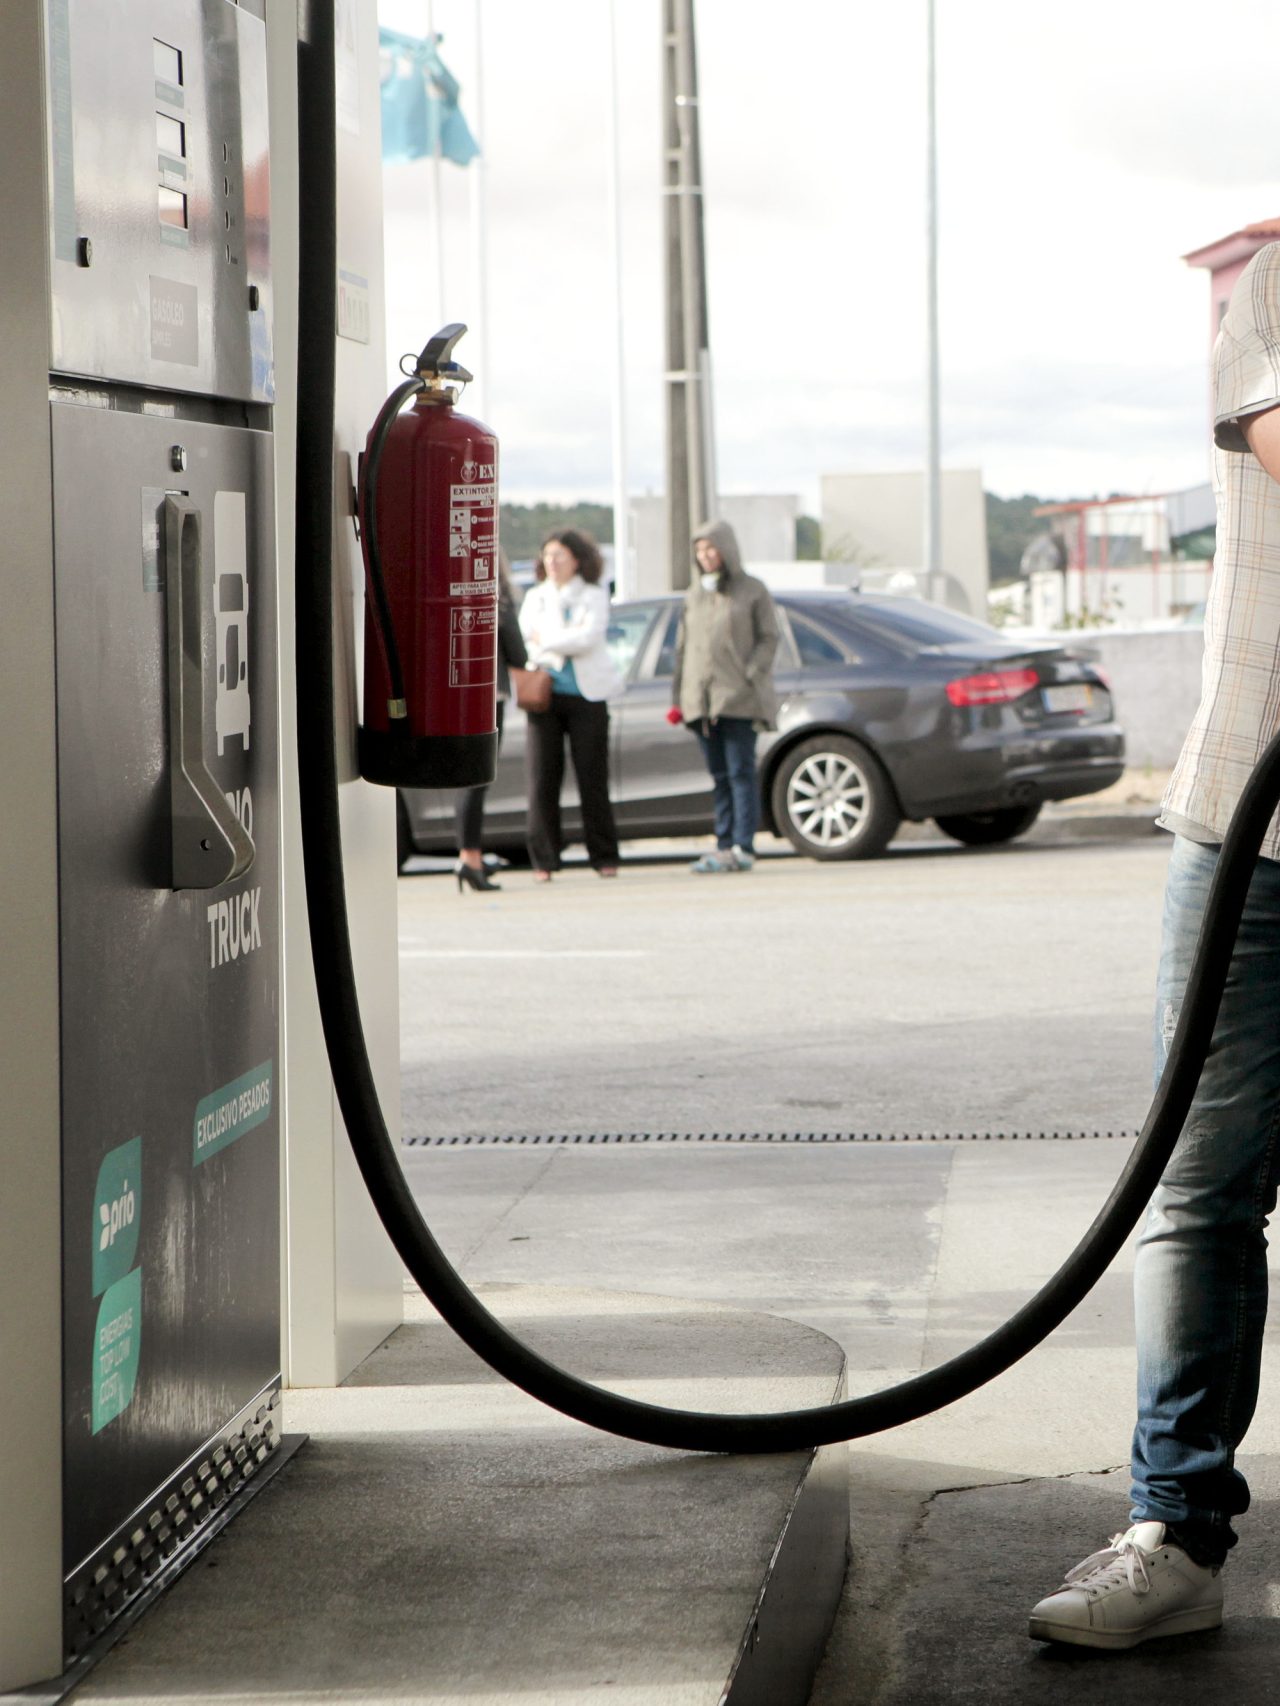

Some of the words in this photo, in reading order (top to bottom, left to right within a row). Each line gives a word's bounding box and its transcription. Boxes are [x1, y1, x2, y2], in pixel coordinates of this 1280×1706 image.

[453, 487, 489, 496] EXTINTOR
[207, 887, 262, 969] TRUCK
[197, 1098, 237, 1149] EXCLUSIVO
[239, 1078, 270, 1122] PESADOS
[110, 1179, 134, 1246] prio
